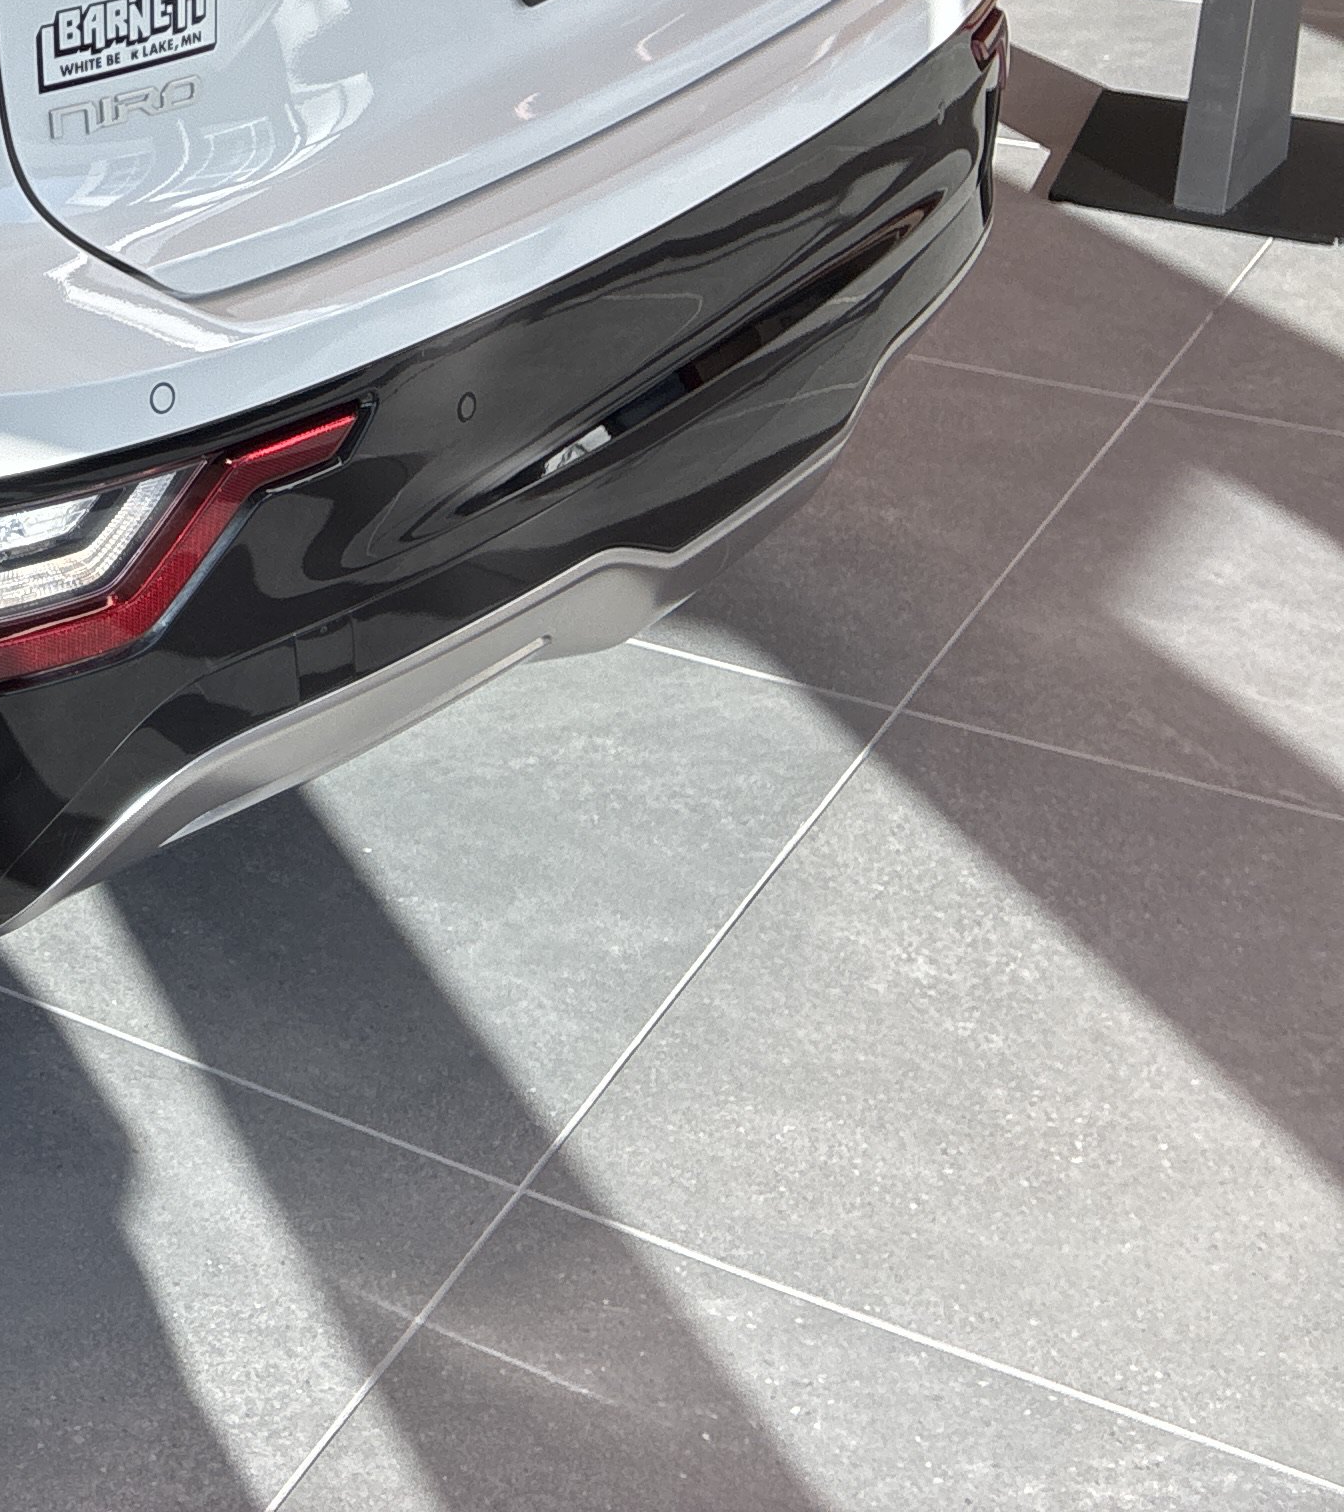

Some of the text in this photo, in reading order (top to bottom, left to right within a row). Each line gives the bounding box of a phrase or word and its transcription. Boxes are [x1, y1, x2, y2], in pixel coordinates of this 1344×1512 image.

[60, 56, 103, 77] WHITE
[141, 37, 179, 58] LAKE,
[180, 30, 203, 48] MN
